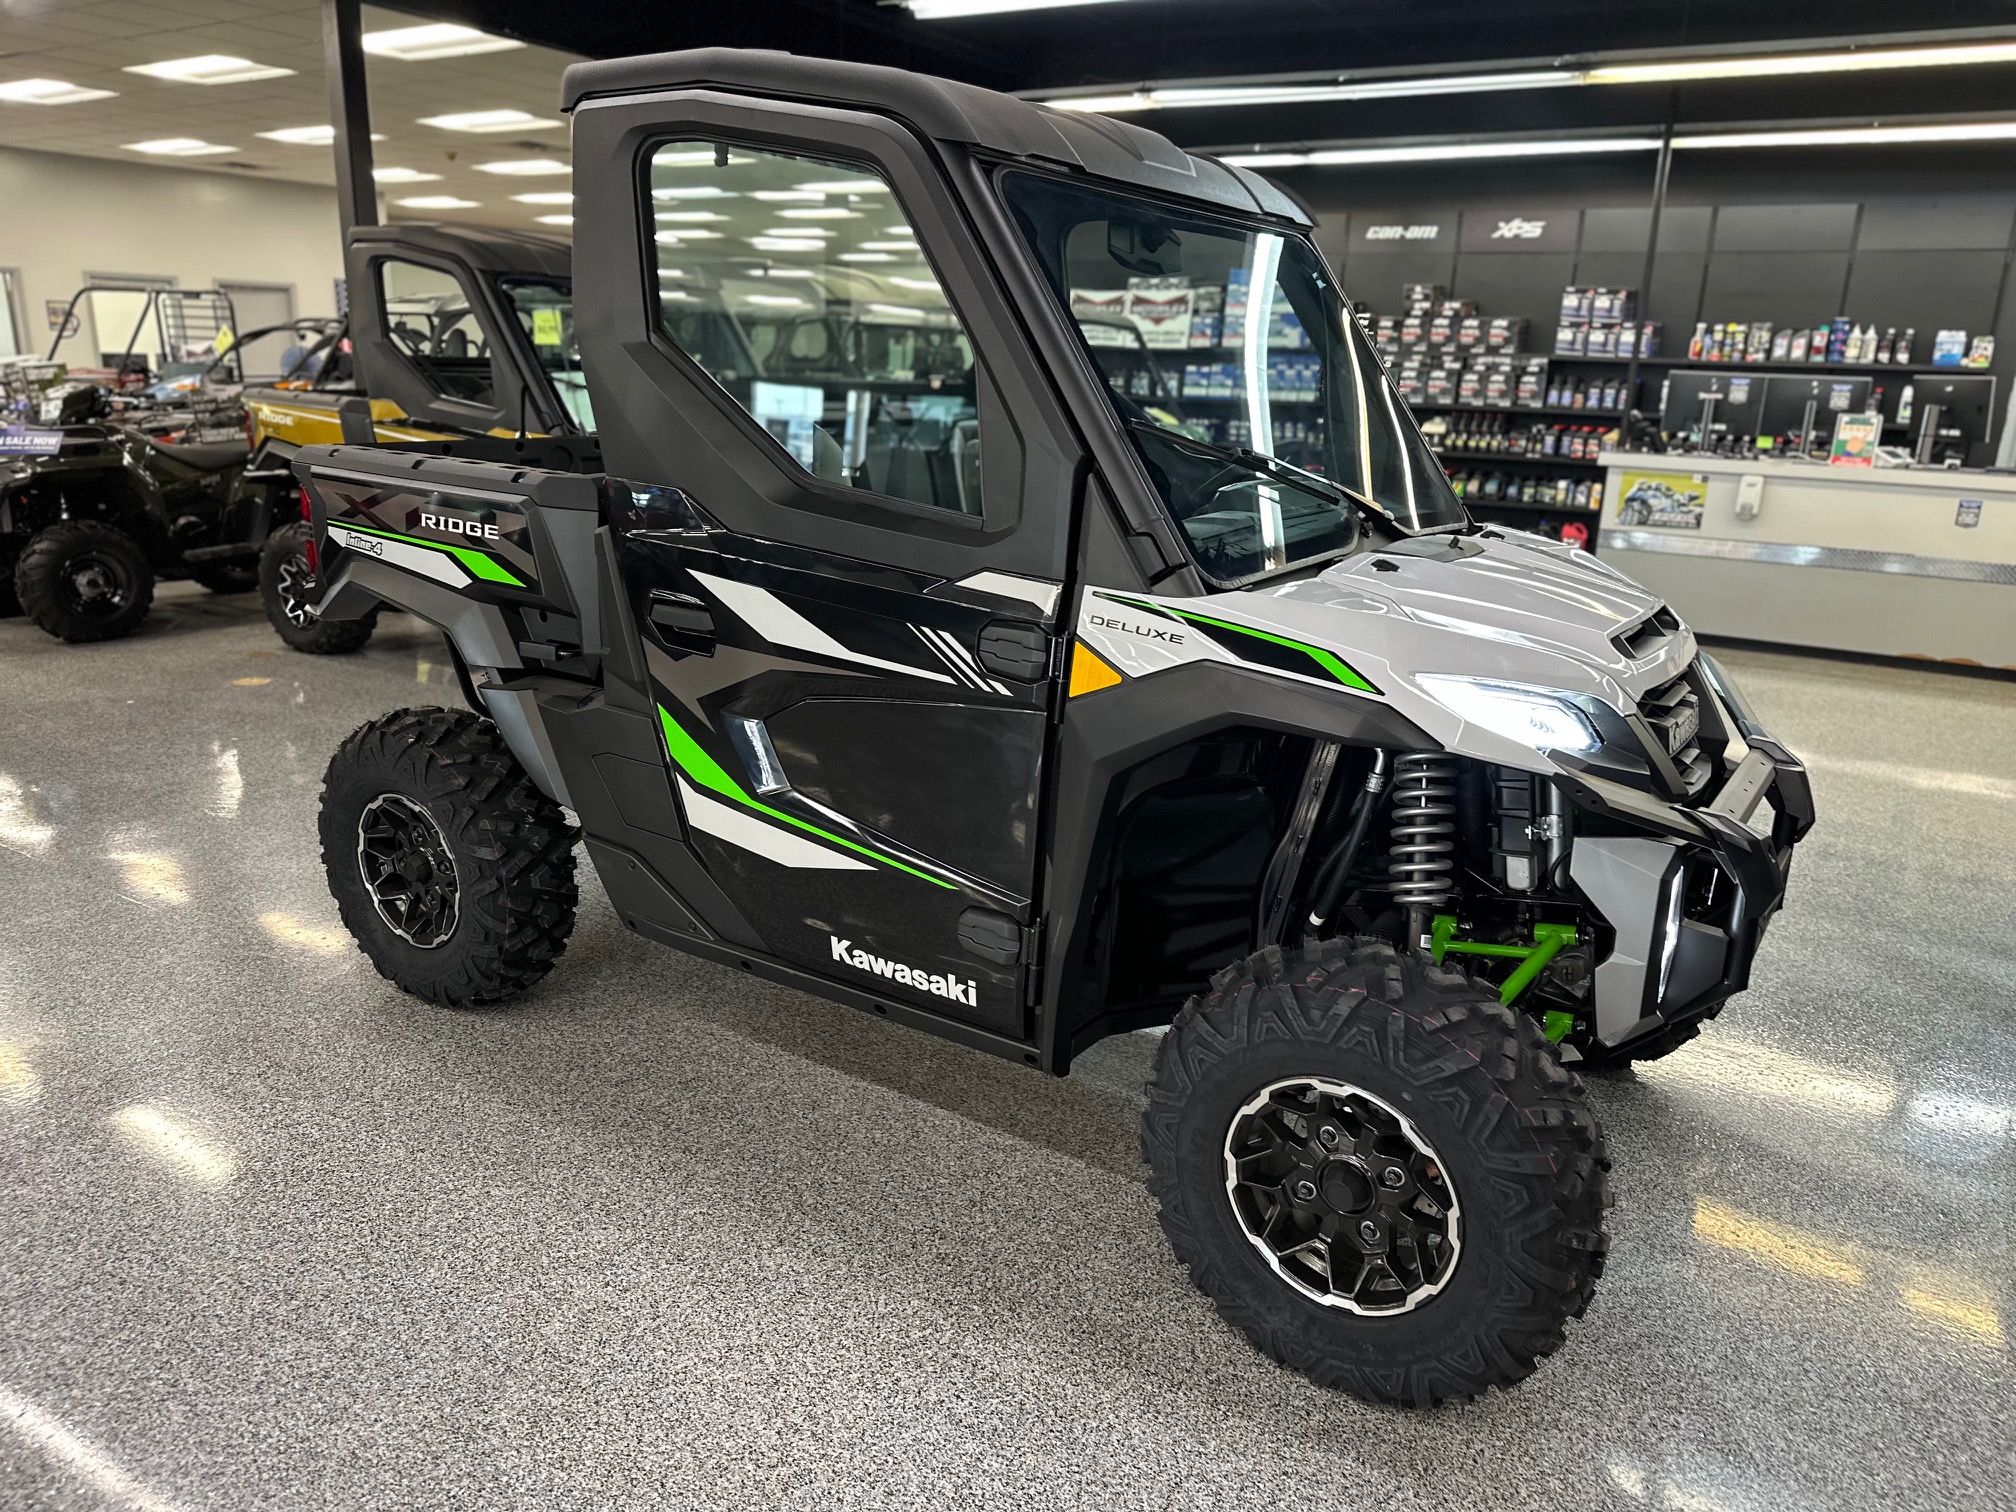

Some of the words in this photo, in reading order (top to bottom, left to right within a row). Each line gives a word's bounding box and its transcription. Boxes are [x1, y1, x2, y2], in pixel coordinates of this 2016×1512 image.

[4, 436, 32, 445] SALE
[33, 436, 58, 445] NOW
[421, 512, 500, 540] RIDGE
[346, 532, 383, 556] Inline-4
[1090, 614, 1185, 645] DELUXE
[831, 935, 977, 1007] Kawasaki
